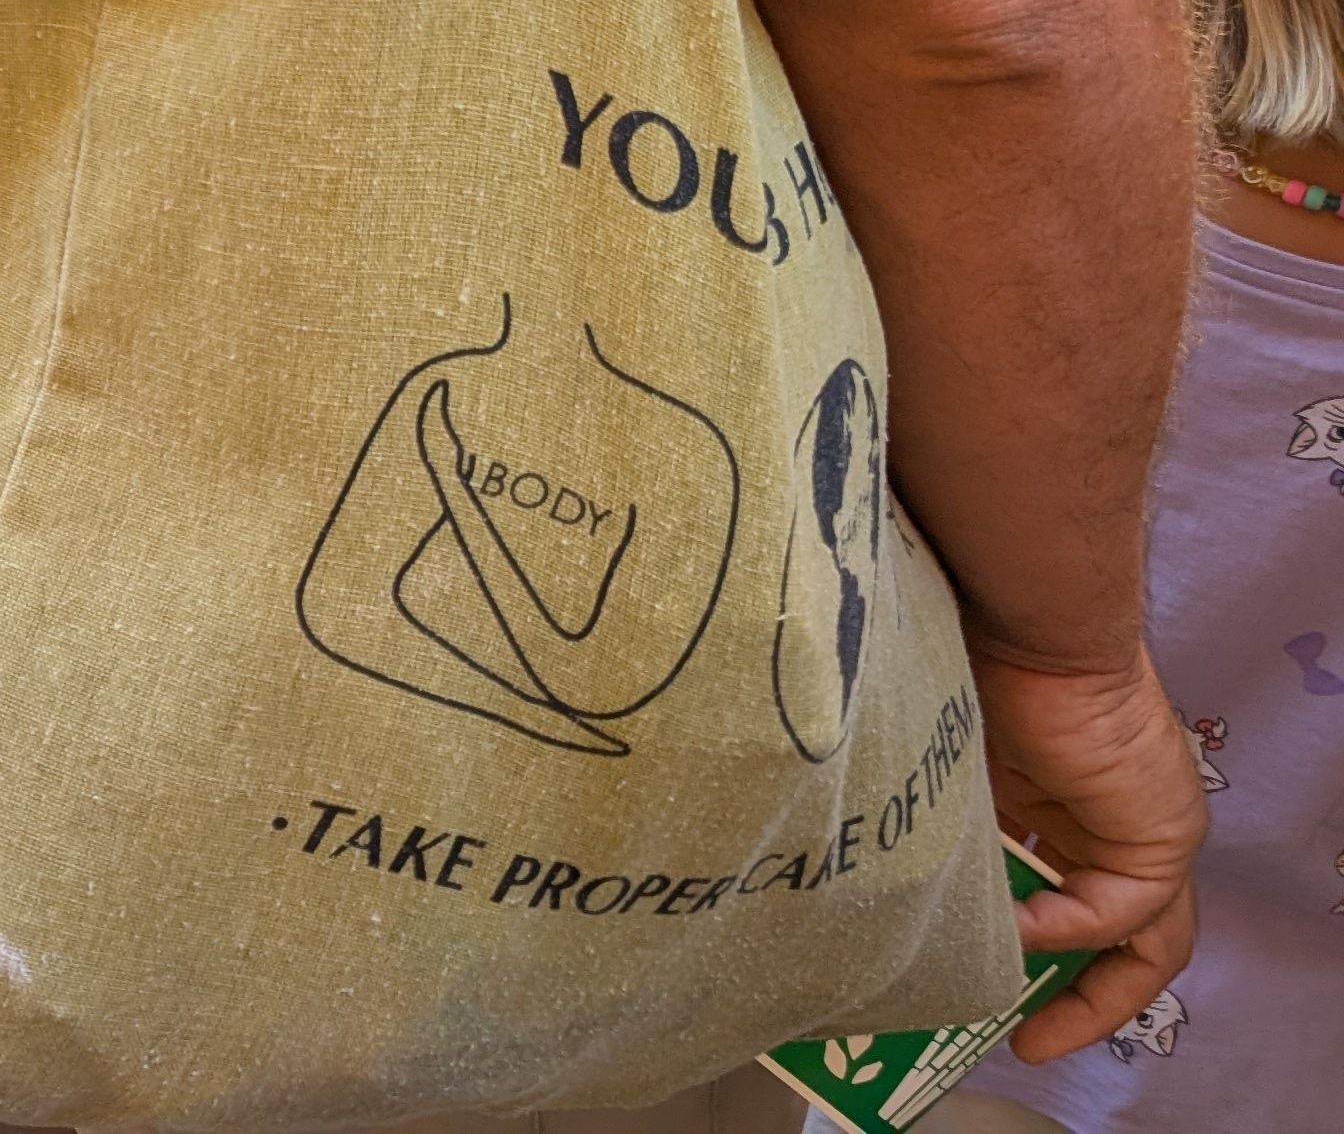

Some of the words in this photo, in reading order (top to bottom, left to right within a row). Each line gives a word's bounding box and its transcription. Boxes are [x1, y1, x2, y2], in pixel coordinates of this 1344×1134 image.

[480, 462, 612, 536] BODY
[490, 854, 736, 916] PROPER
[877, 770, 919, 851] OF
